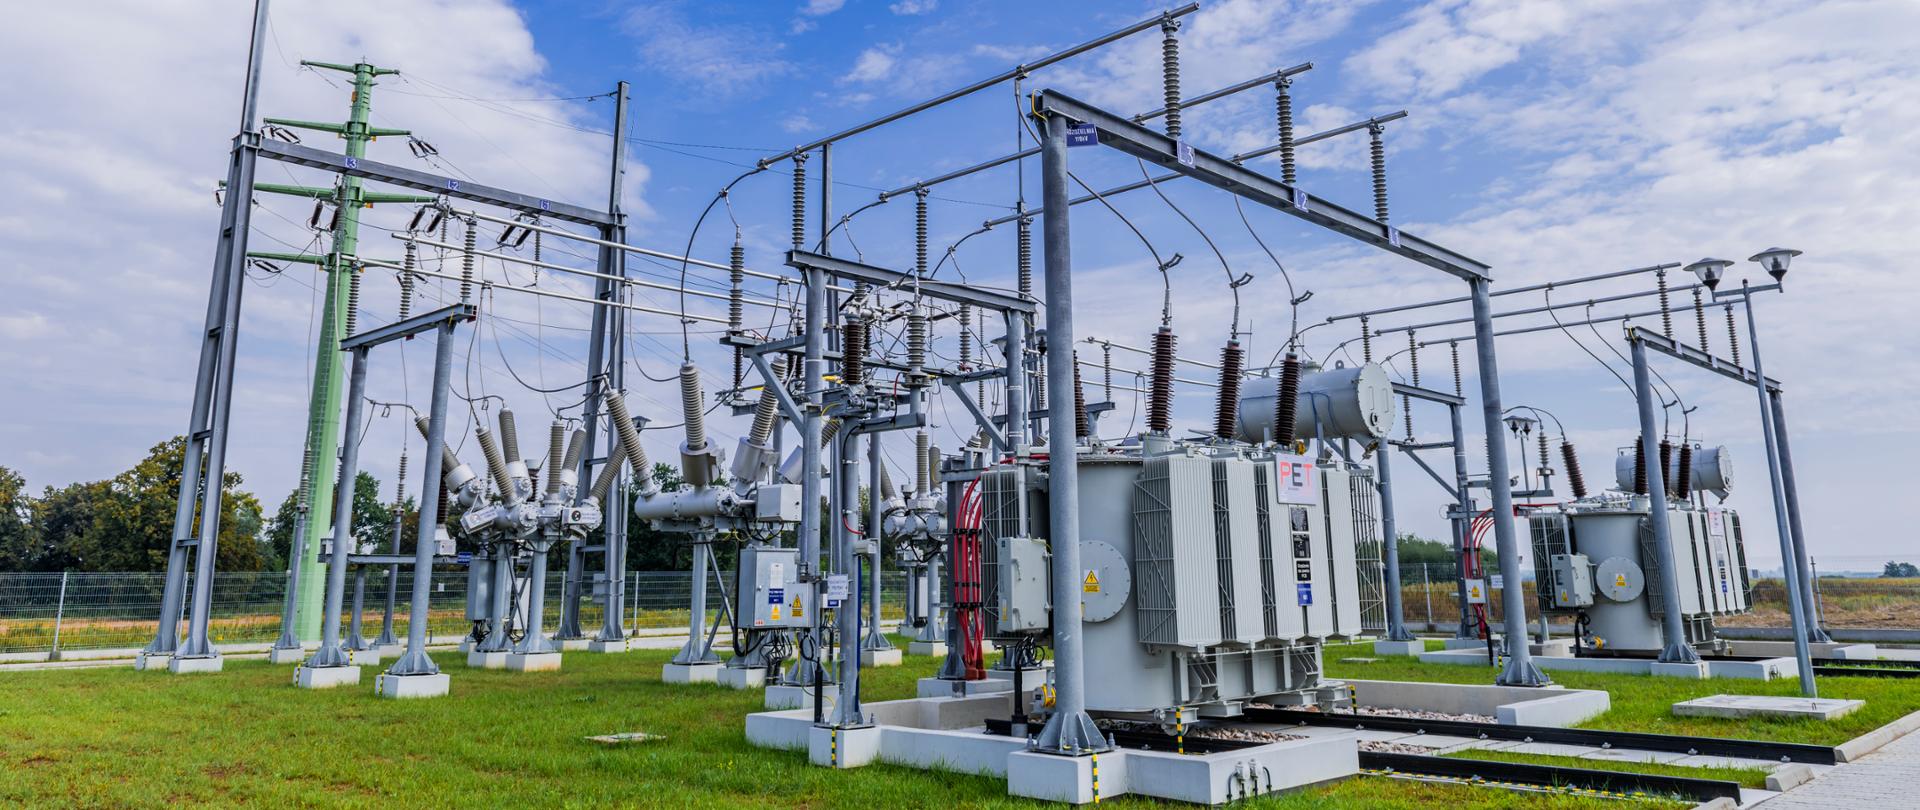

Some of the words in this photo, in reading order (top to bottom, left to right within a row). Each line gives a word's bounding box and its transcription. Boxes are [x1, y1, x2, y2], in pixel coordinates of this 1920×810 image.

[345, 157, 356, 169] L3
[1179, 142, 1194, 165] L3
[447, 179, 459, 191] L2
[1295, 189, 1307, 210] L2
[1389, 228, 1399, 245] L1
[1280, 461, 1312, 487] PET
